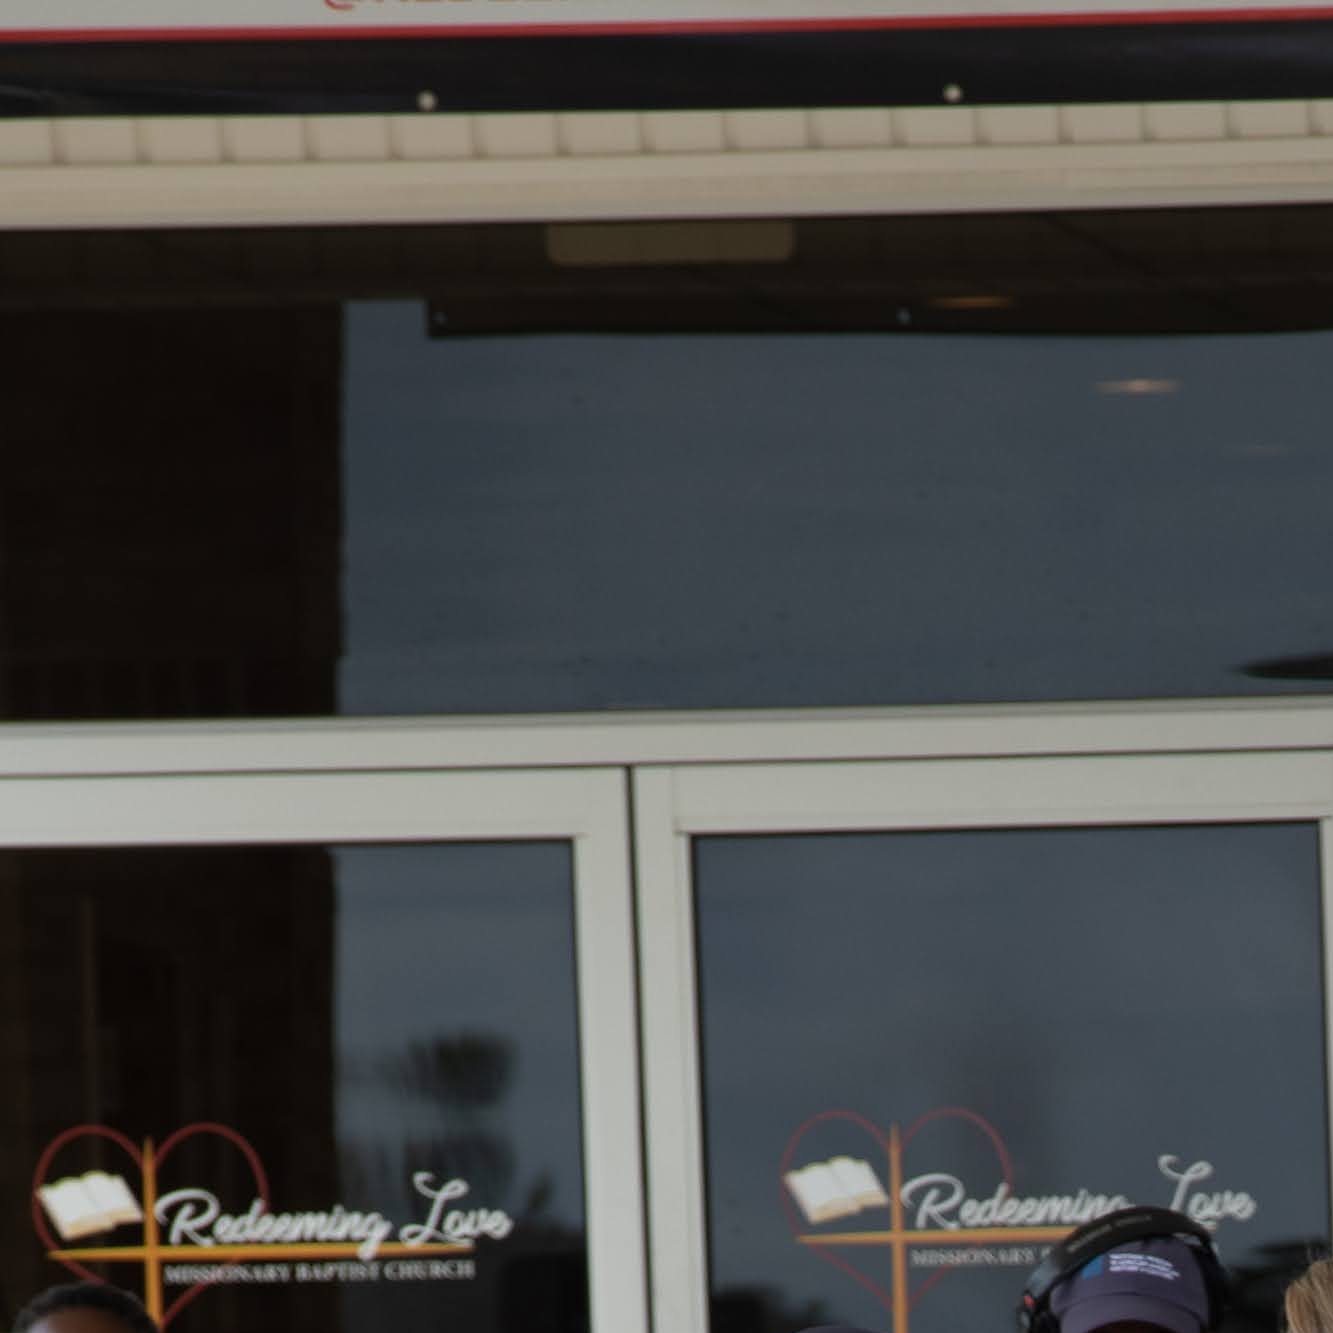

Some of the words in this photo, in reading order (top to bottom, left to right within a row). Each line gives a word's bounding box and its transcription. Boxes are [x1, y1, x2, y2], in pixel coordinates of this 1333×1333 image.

[155, 1188, 391, 1260] Redeeming
[401, 1171, 514, 1247] Love
[911, 1247, 1033, 1268] MISSIONARY
[164, 1262, 293, 1285] MISSIONARY
[296, 1261, 381, 1283] BAPTIST
[385, 1259, 476, 1281] CHURCH
